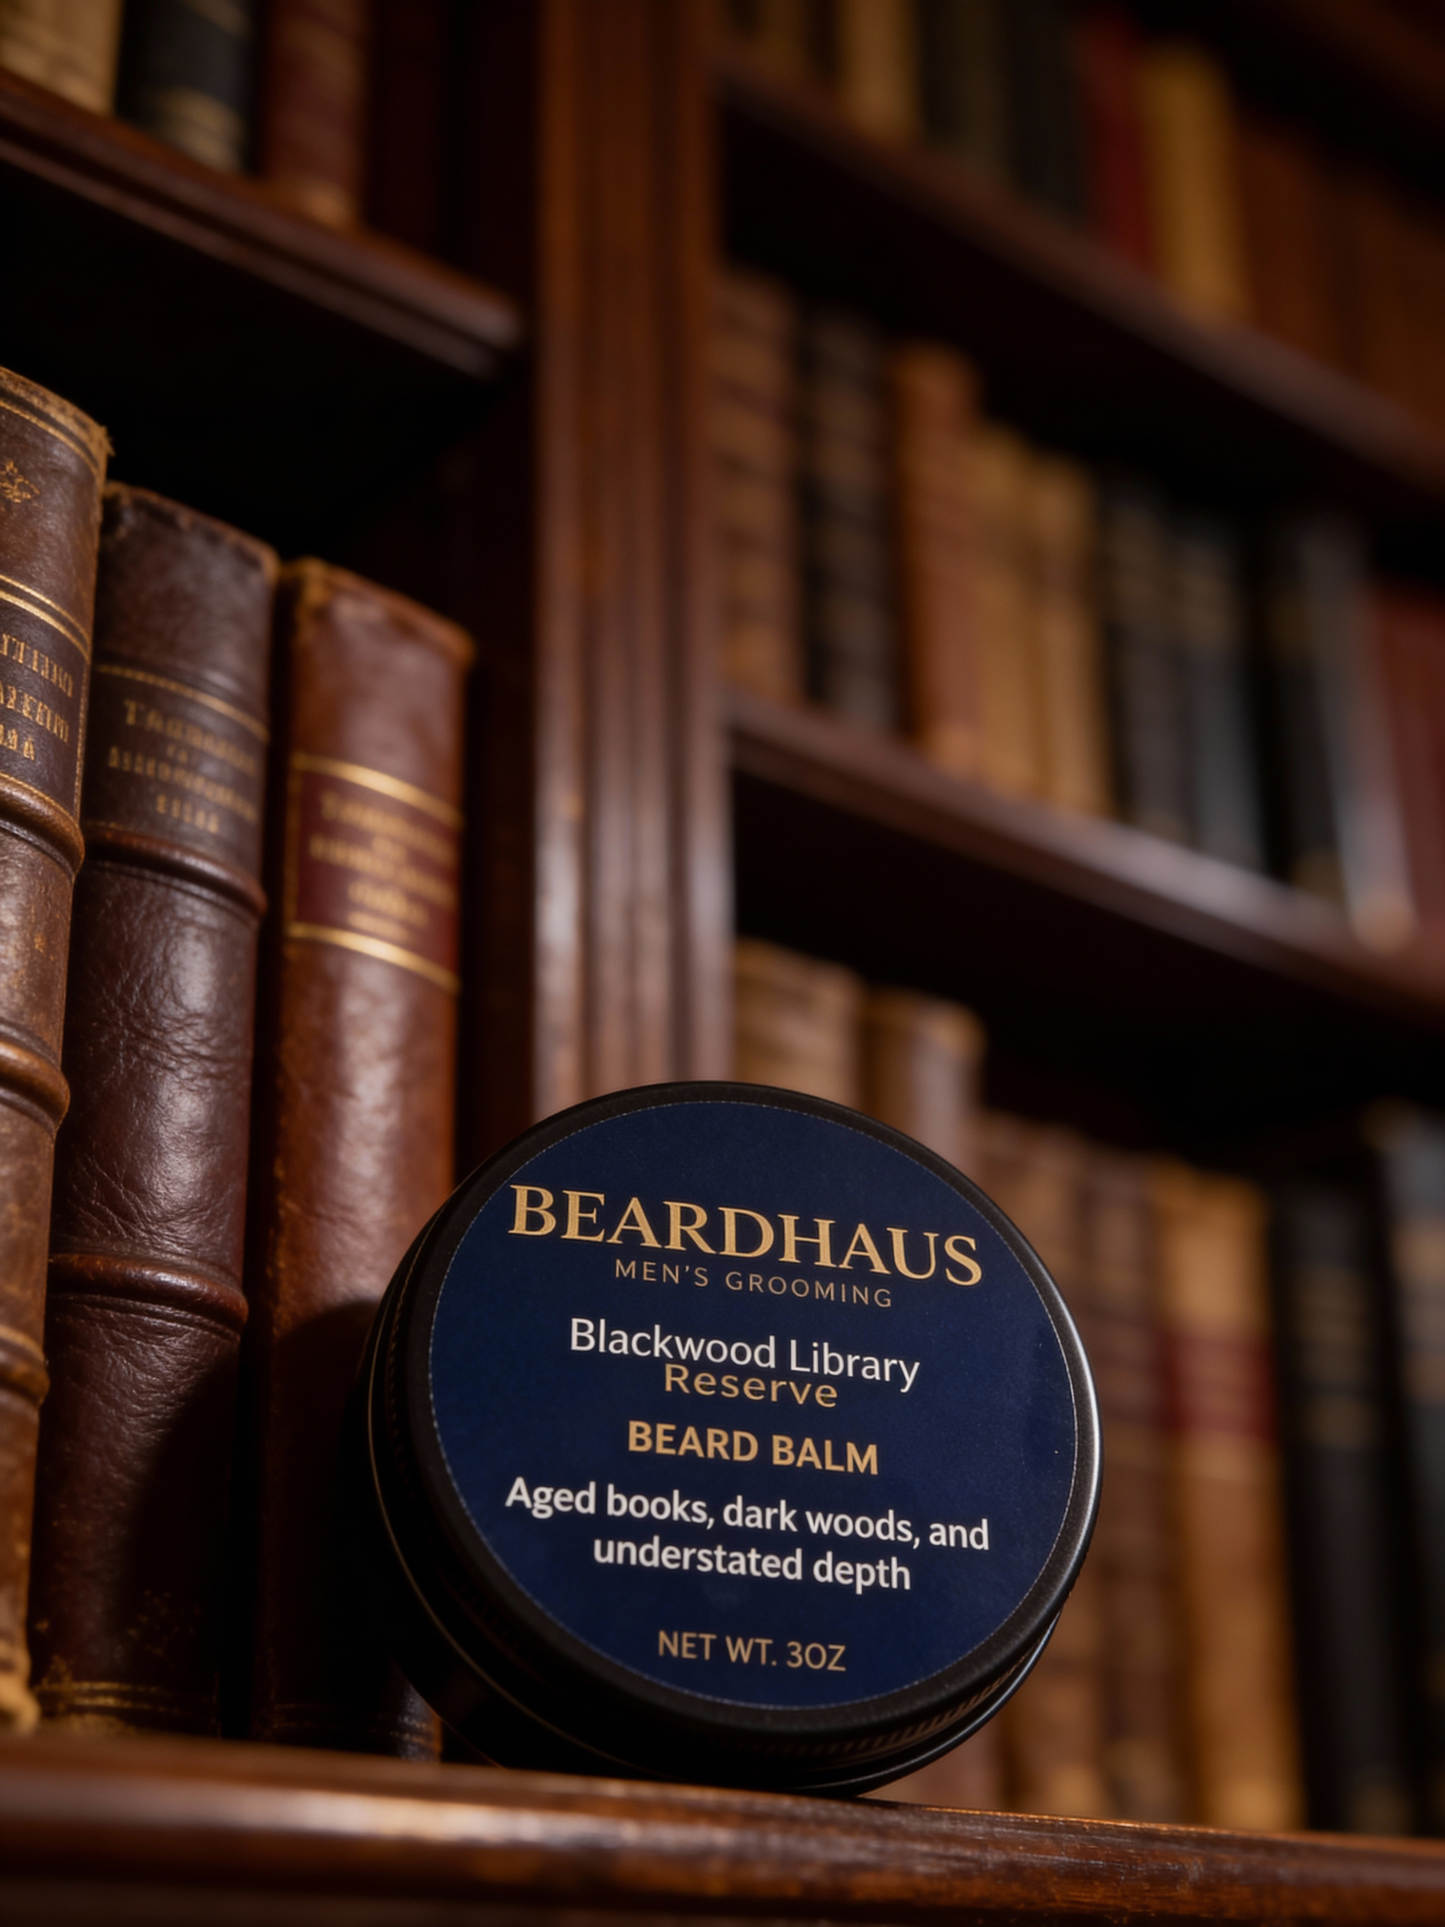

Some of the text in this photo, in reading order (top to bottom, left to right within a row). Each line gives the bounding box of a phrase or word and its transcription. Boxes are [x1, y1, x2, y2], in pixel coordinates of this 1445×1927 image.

[508, 1184, 982, 1287] BEARDHAUS
[615, 1258, 892, 1308] MEN'S GROOMING
[570, 1317, 921, 1393] Blackwood Library
[664, 1363, 838, 1408] Reserve
[628, 1420, 879, 1475] BEARD BALM
[505, 1477, 990, 1551] Aged books, dark woods, and
[594, 1535, 911, 1595] understated depth
[658, 1631, 846, 1672] NET WT. 3OZ
